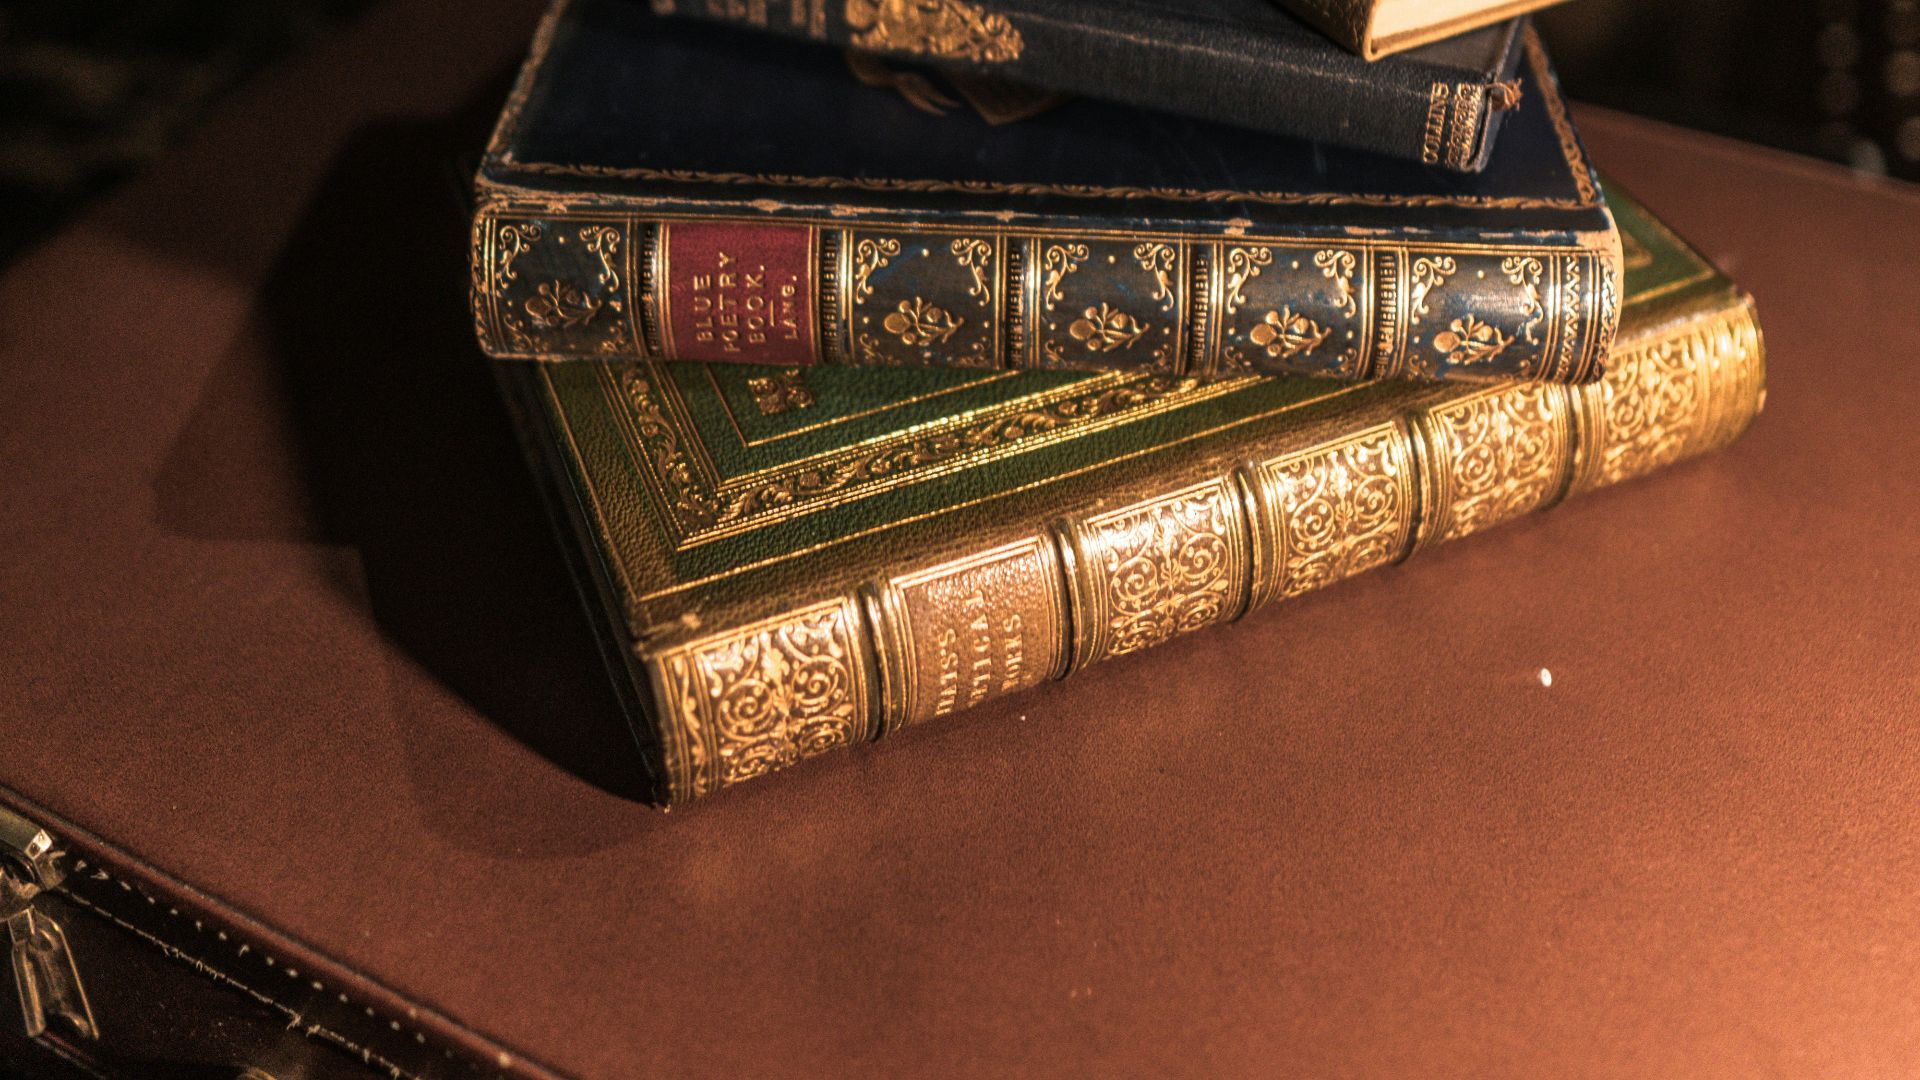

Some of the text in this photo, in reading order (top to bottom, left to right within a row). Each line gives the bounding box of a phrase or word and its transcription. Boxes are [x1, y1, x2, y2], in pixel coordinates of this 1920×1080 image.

[1421, 82, 1450, 164] COLLINS
[694, 273, 714, 342] BLUE
[719, 251, 741, 353] POETRY
[745, 264, 767, 344] BOOK.
[777, 274, 799, 340] LANG.
